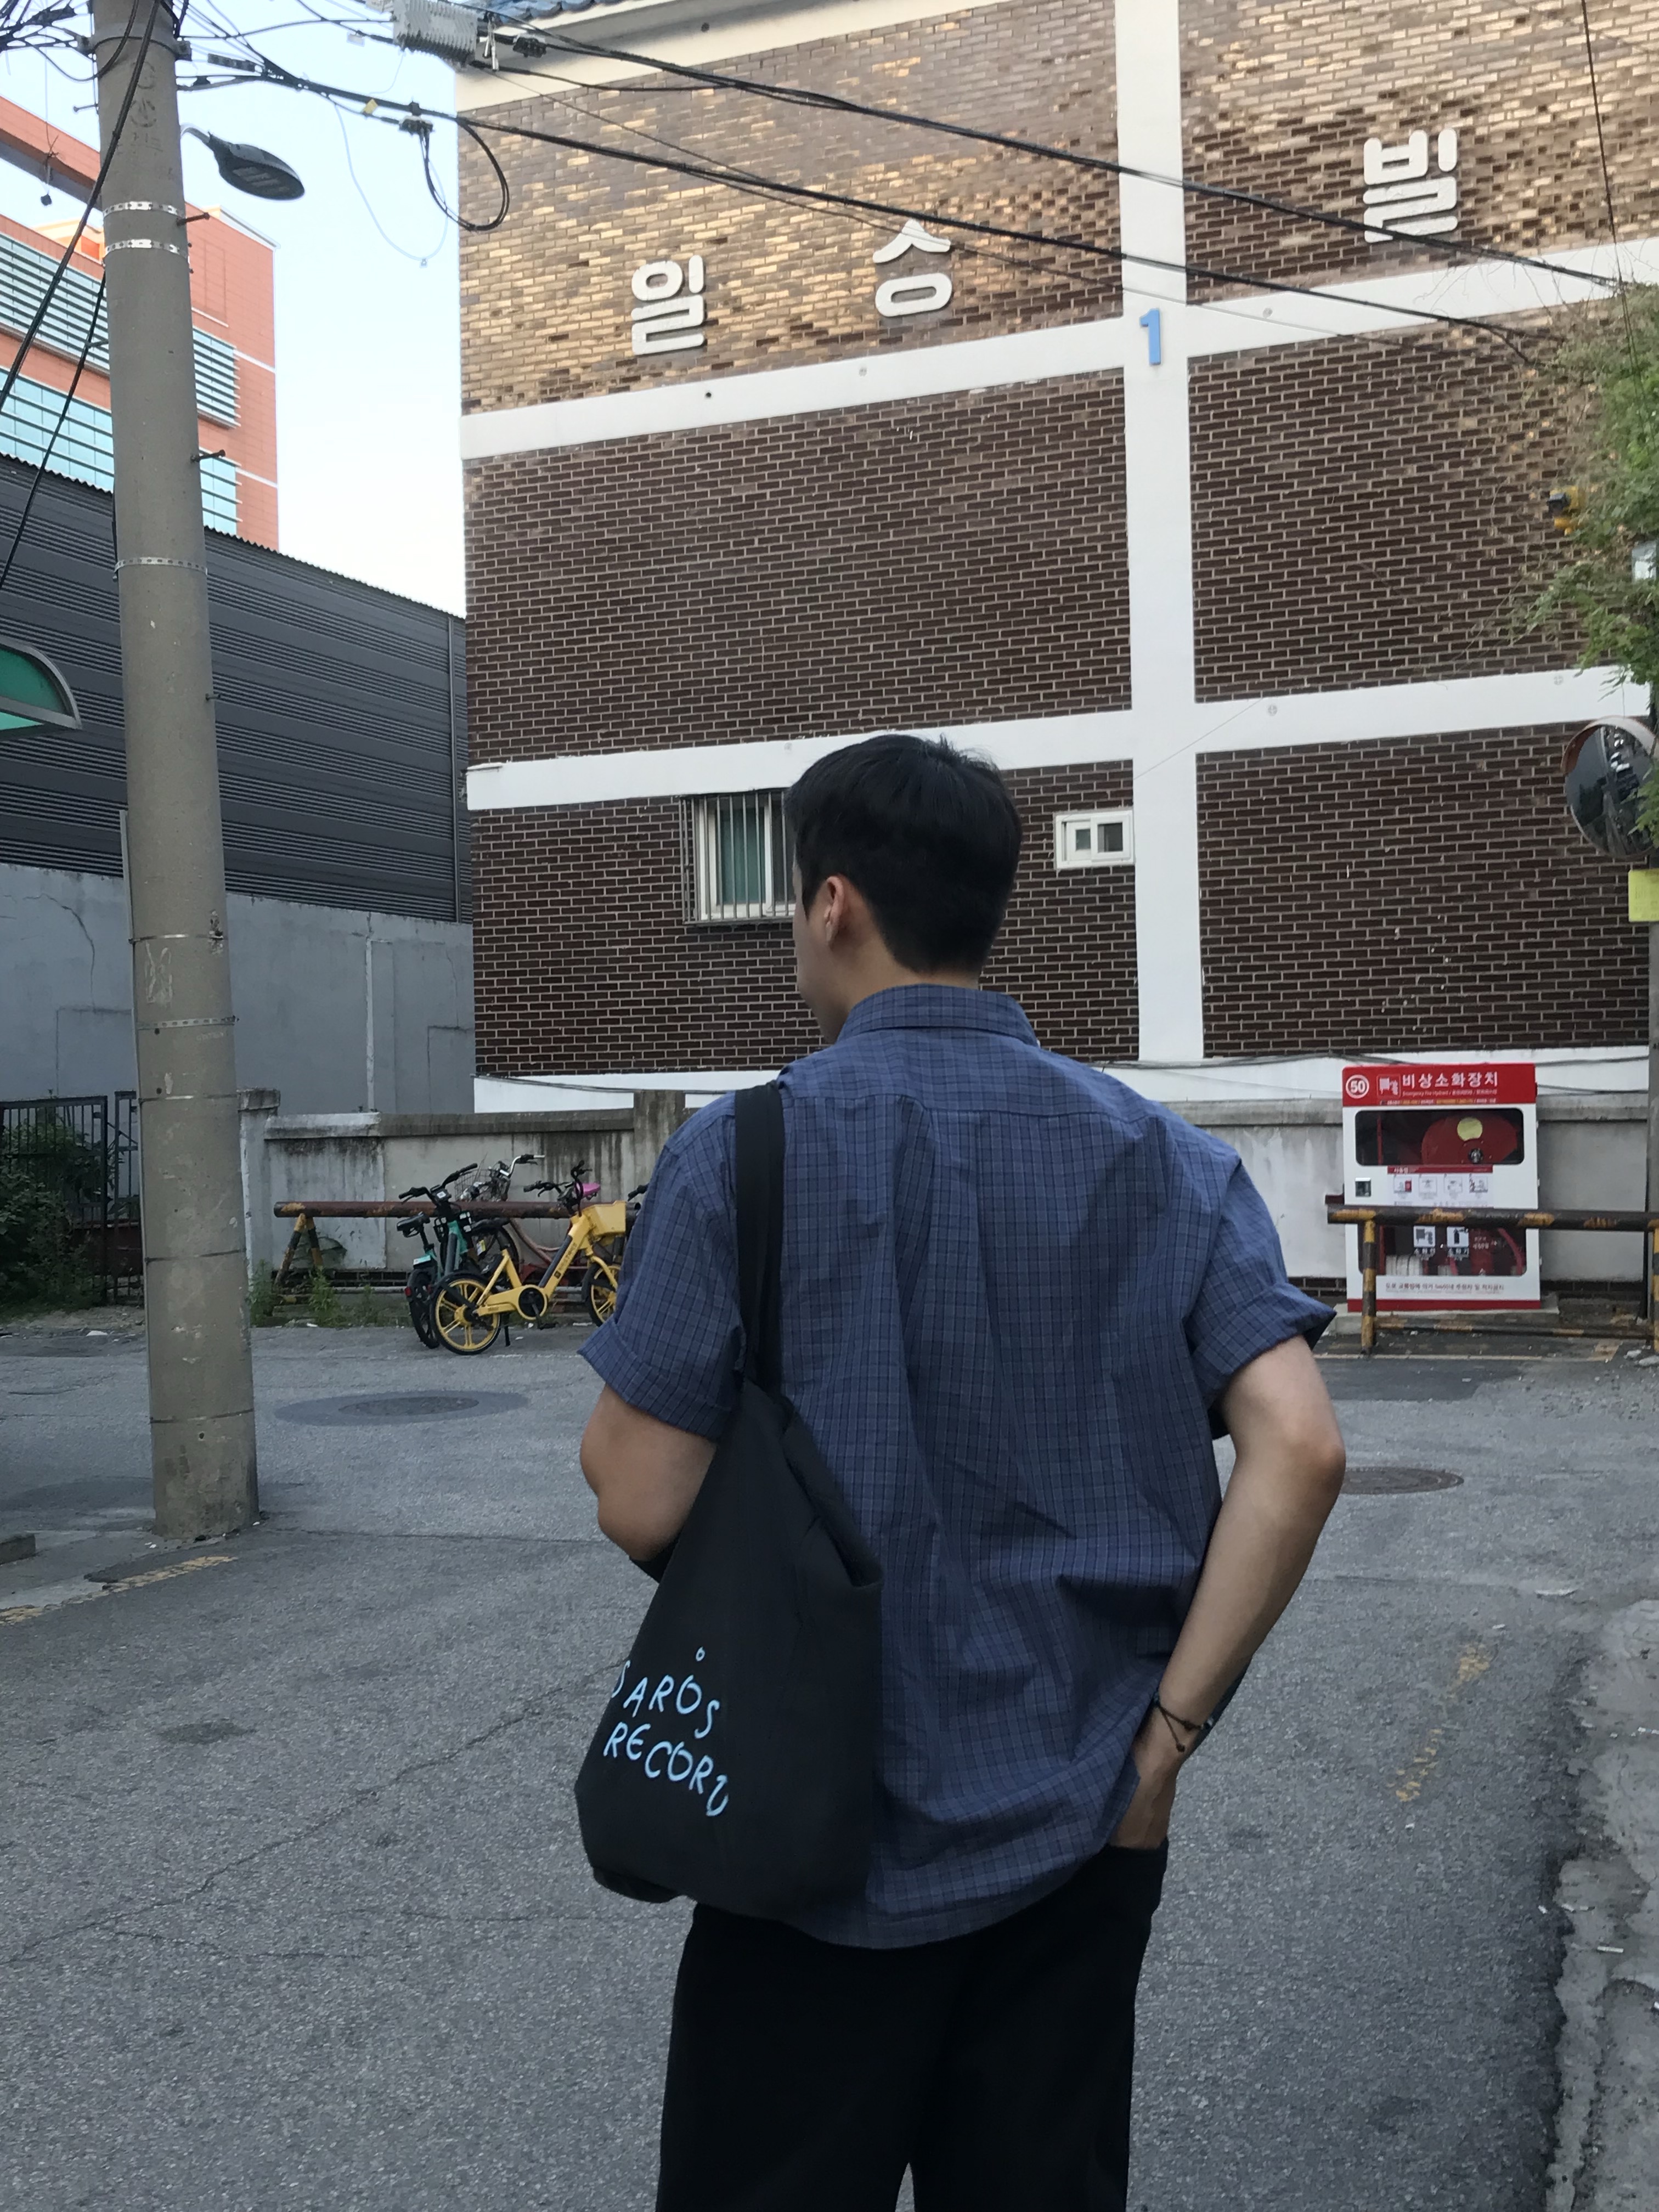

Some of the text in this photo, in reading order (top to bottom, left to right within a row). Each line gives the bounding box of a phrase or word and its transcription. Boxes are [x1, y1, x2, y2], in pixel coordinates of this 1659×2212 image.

[631, 128, 1458, 356] 일 승 빌
[1139, 307, 1161, 366] 1
[1350, 1071, 1498, 1093] 50 비상소화장치
